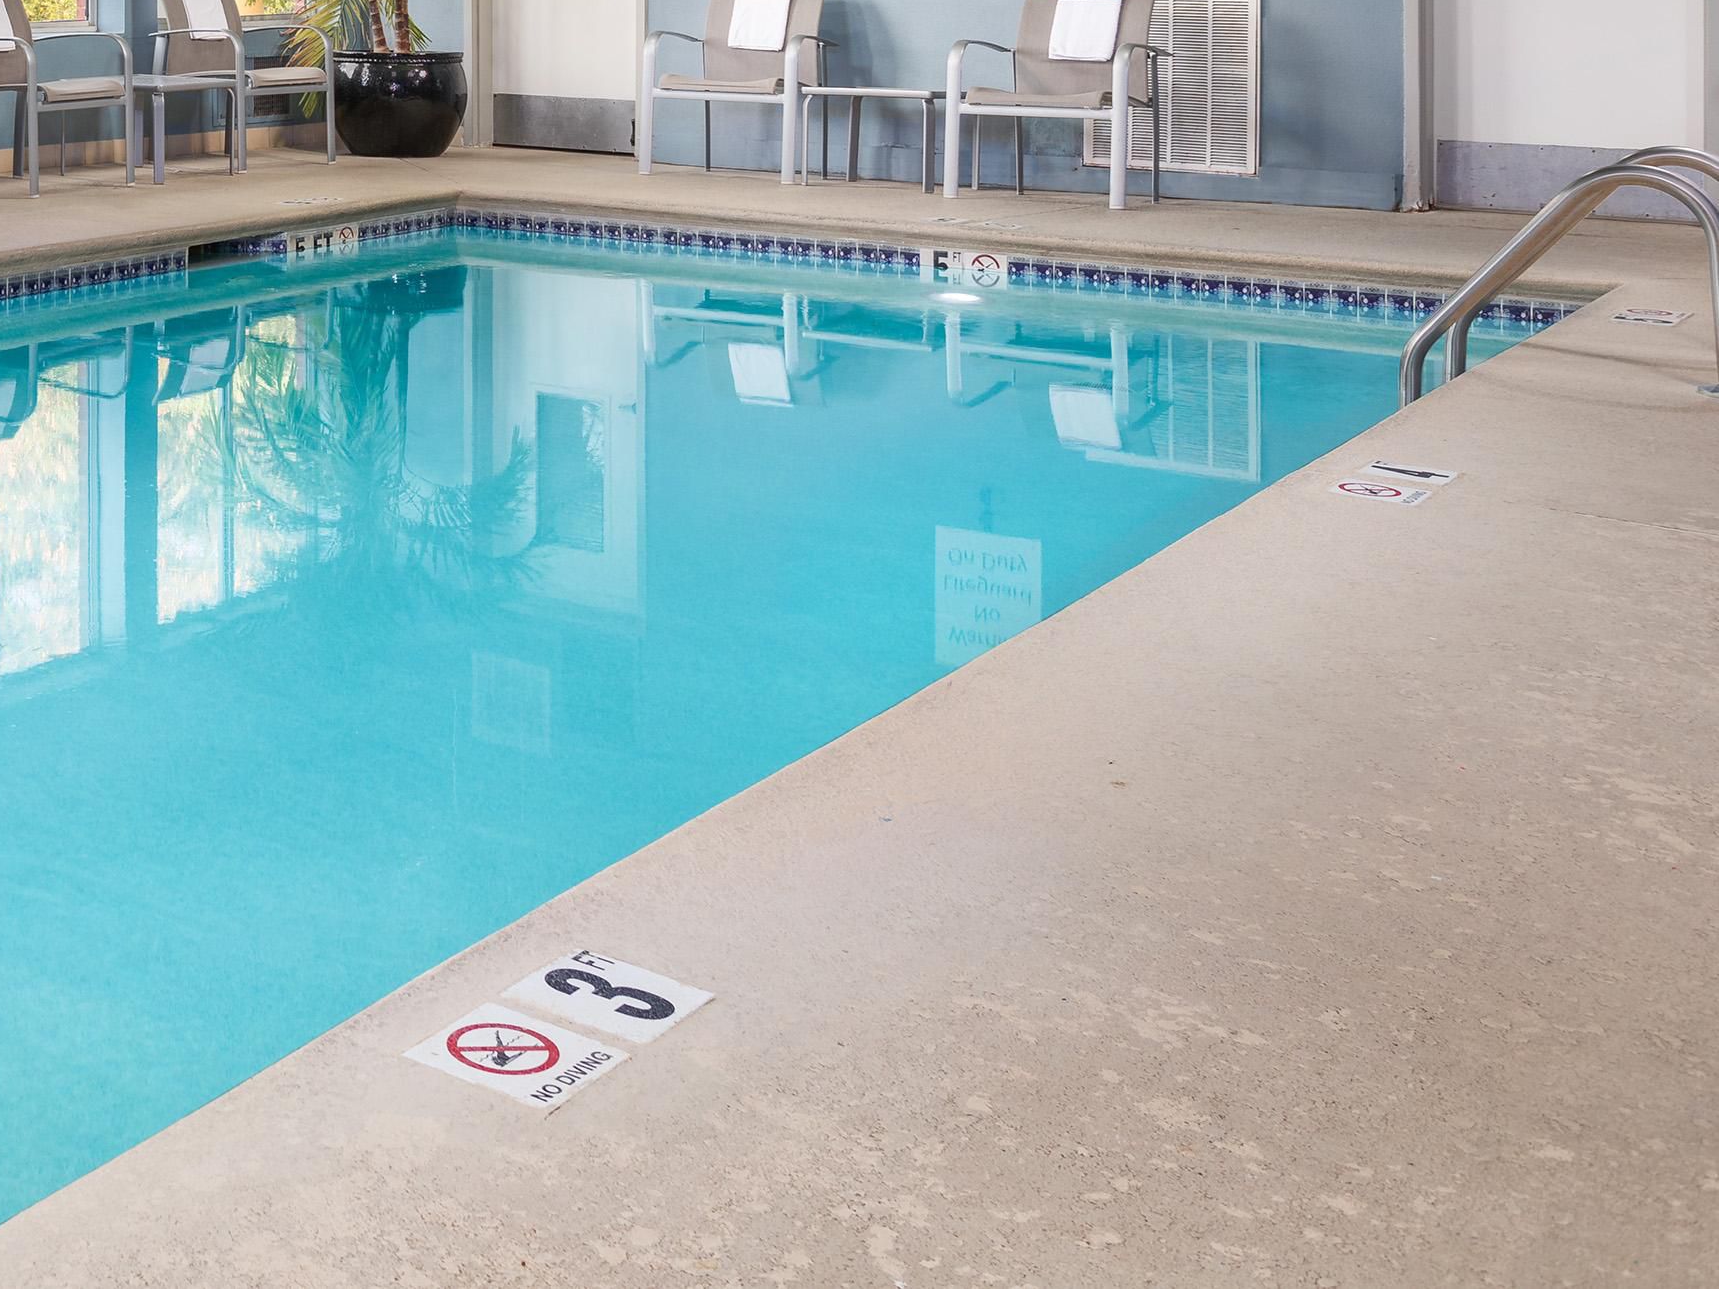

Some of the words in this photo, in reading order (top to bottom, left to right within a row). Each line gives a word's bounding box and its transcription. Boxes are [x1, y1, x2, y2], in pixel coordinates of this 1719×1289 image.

[295, 237, 305, 253] 5
[313, 232, 333, 250] FT
[952, 251, 962, 263] FT
[571, 949, 616, 971] FT
[544, 968, 676, 1020] 3
[530, 1084, 563, 1103] NO
[555, 1051, 614, 1086] DIVING
